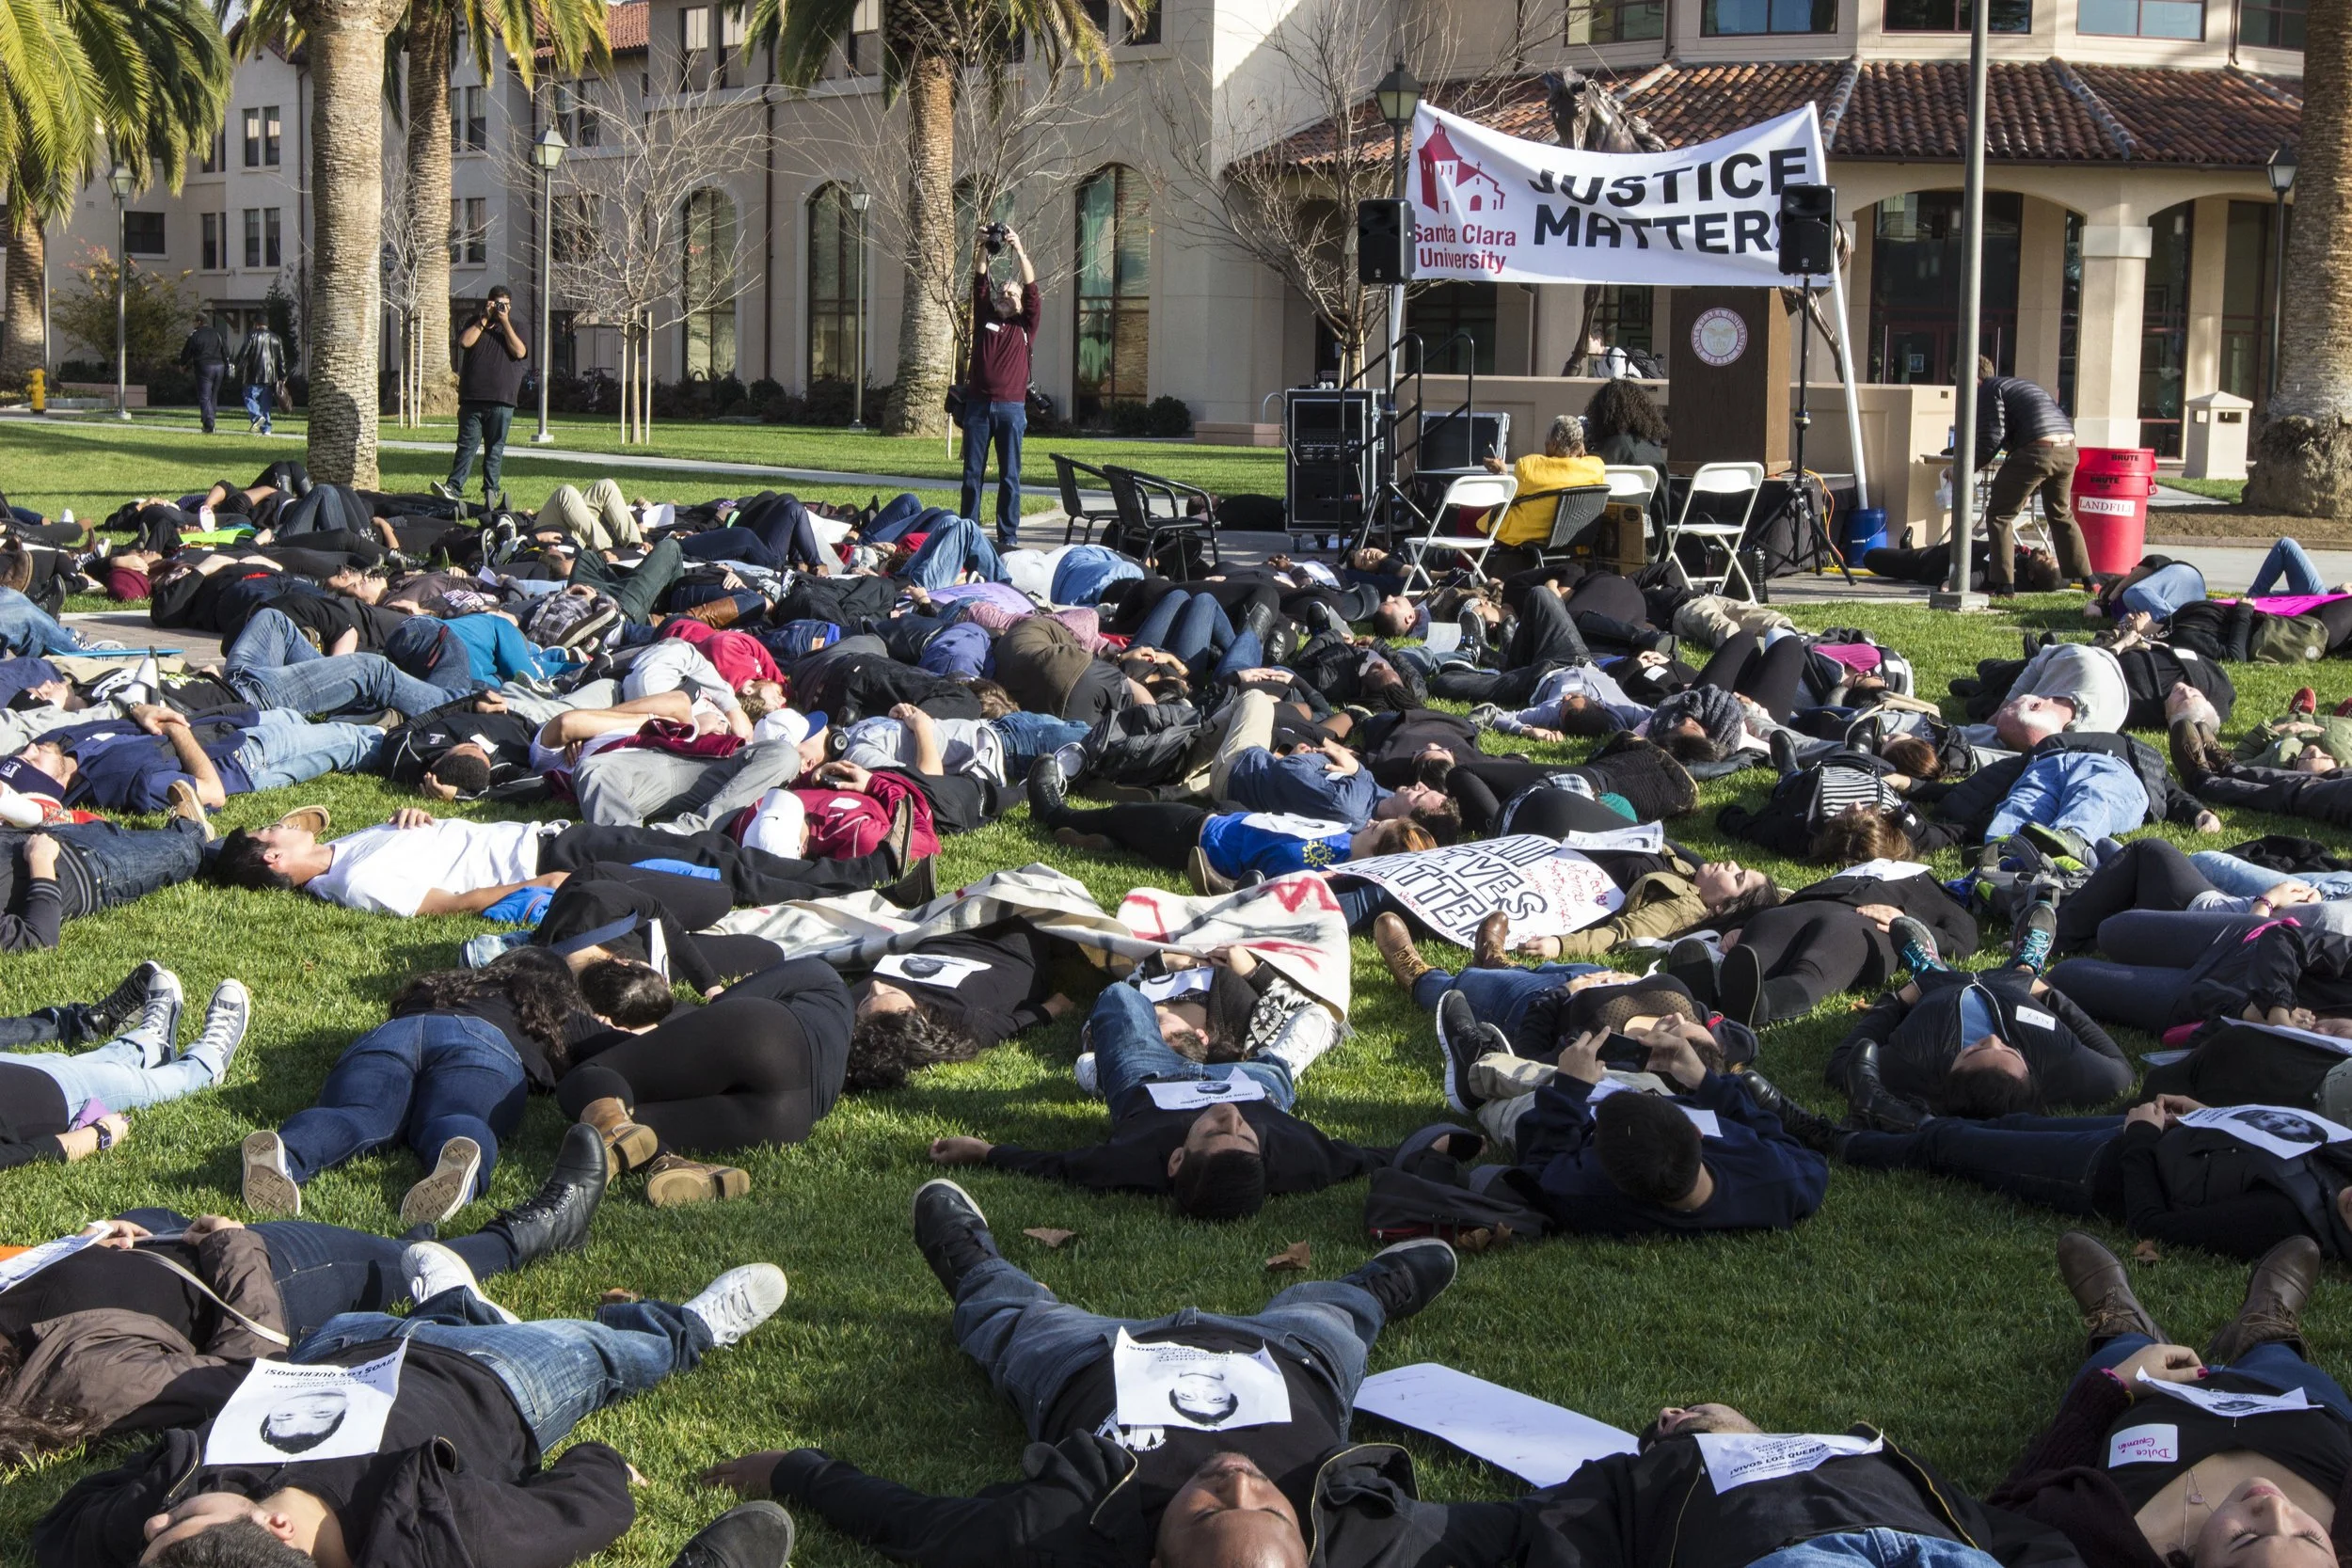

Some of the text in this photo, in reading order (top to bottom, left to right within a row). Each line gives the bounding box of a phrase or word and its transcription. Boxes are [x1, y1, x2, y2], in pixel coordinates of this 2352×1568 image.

[1528, 148, 1807, 207] JUSTICE
[1415, 224, 1517, 246] Santa Clara
[1534, 203, 1781, 255] MATTER
[1420, 247, 1507, 275] University
[264, 1368, 337, 1379] QUEREMOS!
[2136, 1448, 2171, 1459] Dulce
[1730, 1461, 1763, 1475] ¡VIVOS
[1765, 1455, 1786, 1465] LOS
